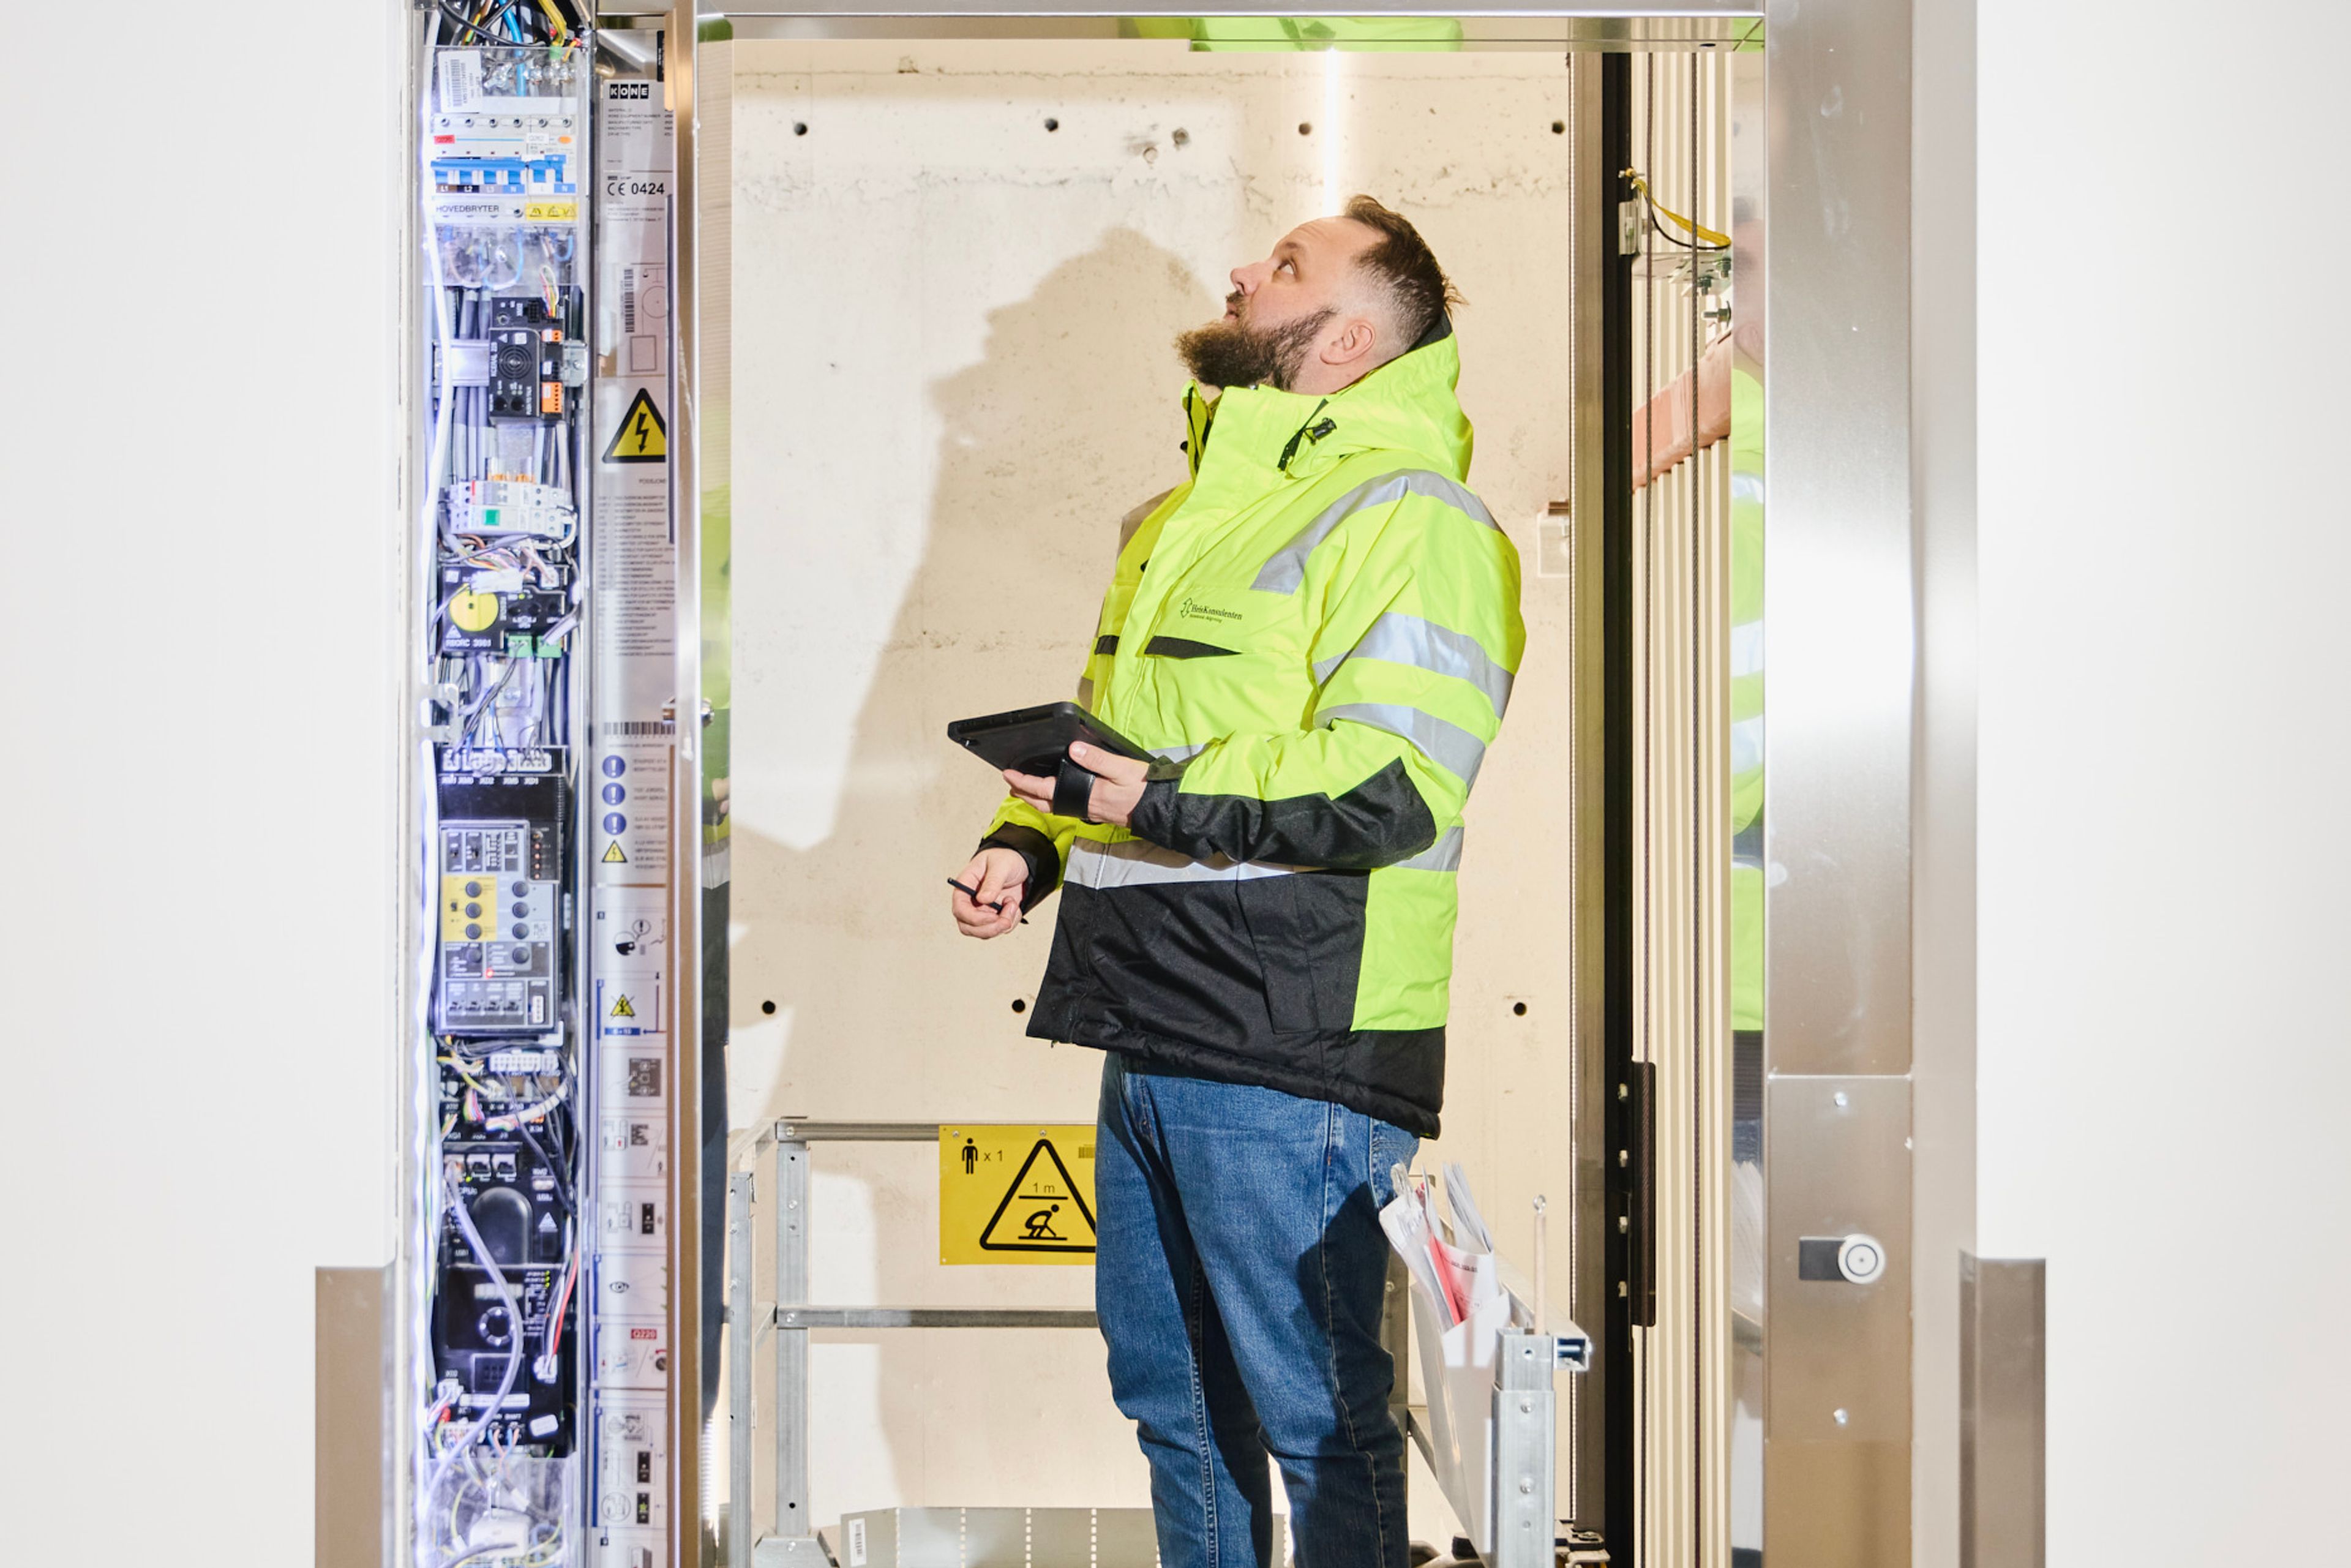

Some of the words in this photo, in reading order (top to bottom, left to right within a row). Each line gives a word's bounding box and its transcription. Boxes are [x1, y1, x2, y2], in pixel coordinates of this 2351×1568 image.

[609, 84, 649, 99] KONE
[631, 182, 664, 195] 0424
[997, 1150, 1003, 1161] 1
[1033, 1183, 1038, 1193] 1
[1044, 1185, 1055, 1193] m
